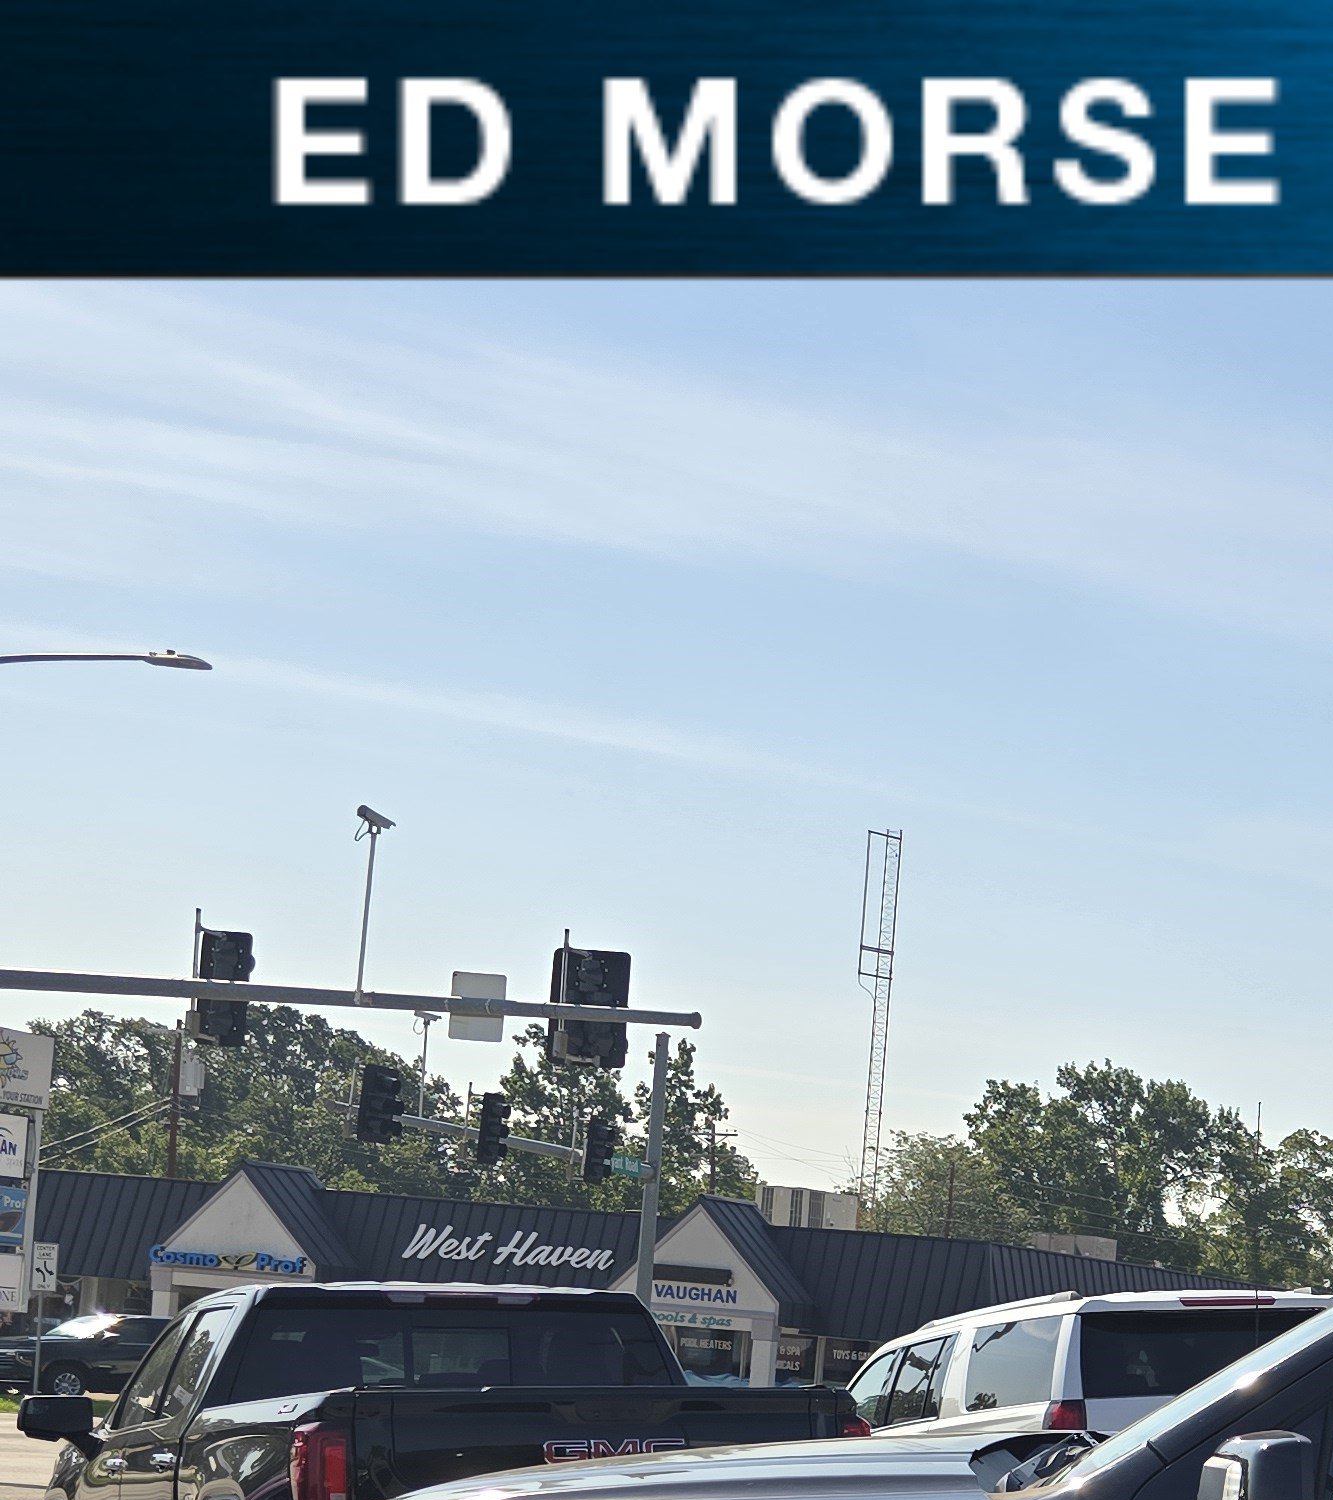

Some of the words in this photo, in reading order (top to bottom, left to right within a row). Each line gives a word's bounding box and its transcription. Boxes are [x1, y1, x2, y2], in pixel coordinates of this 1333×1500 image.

[20, 1093, 43, 1105] STATION
[3, 1195, 26, 1209] Prof
[401, 1223, 493, 1261] West
[493, 1230, 615, 1271] Haven
[148, 1244, 220, 1268] Cosmo
[256, 1252, 307, 1274] Prof
[654, 1283, 738, 1304] VAUGHAN
[700, 1316, 733, 1328] spas
[699, 1338, 733, 1351] HEATERS
[786, 1345, 800, 1356] SPA
[833, 1349, 850, 1360] TOYS
